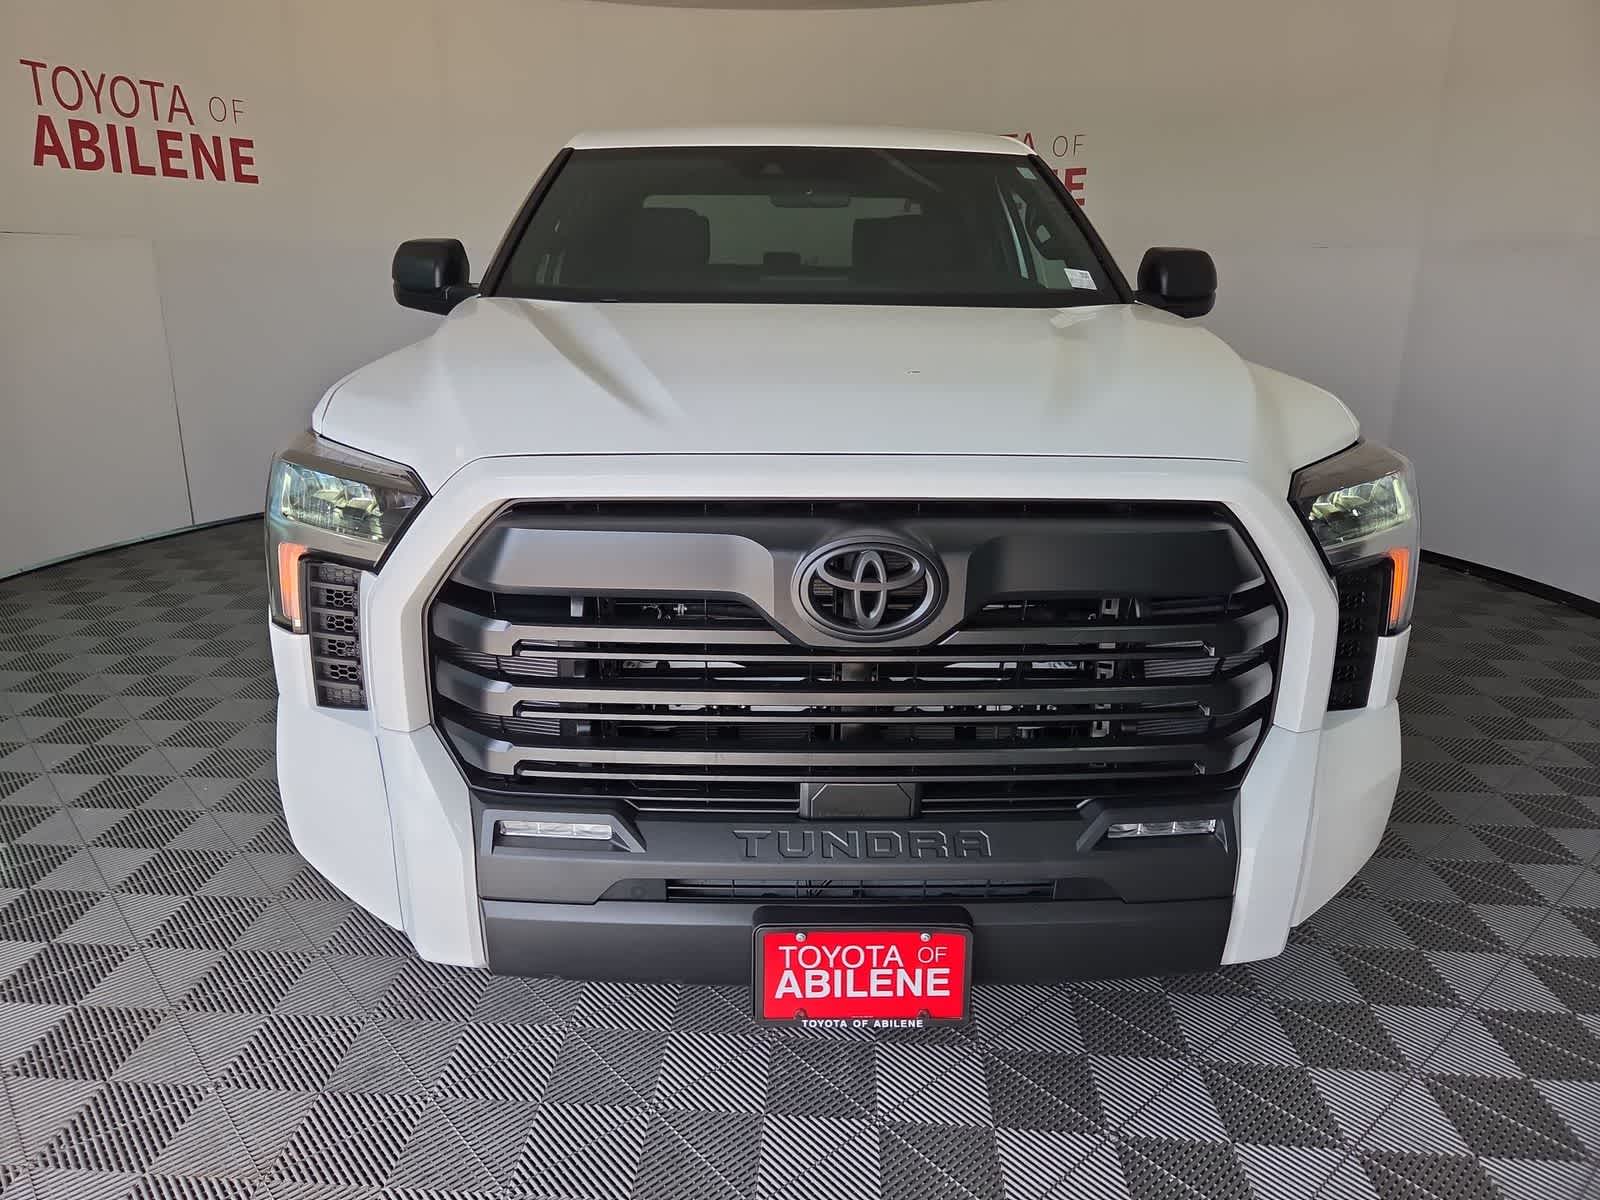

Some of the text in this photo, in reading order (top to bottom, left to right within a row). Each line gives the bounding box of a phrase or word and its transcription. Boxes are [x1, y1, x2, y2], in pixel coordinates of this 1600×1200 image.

[20, 59, 248, 126] TOYOTA OF
[33, 114, 259, 184] ABILENE
[1052, 134, 1087, 158] OF
[732, 829, 992, 859] TUNDRA
[778, 945, 948, 969] TOYOTA OF
[774, 967, 951, 999] ABILENE
[801, 1019, 924, 1028] TOYOTA OF ABILENE
